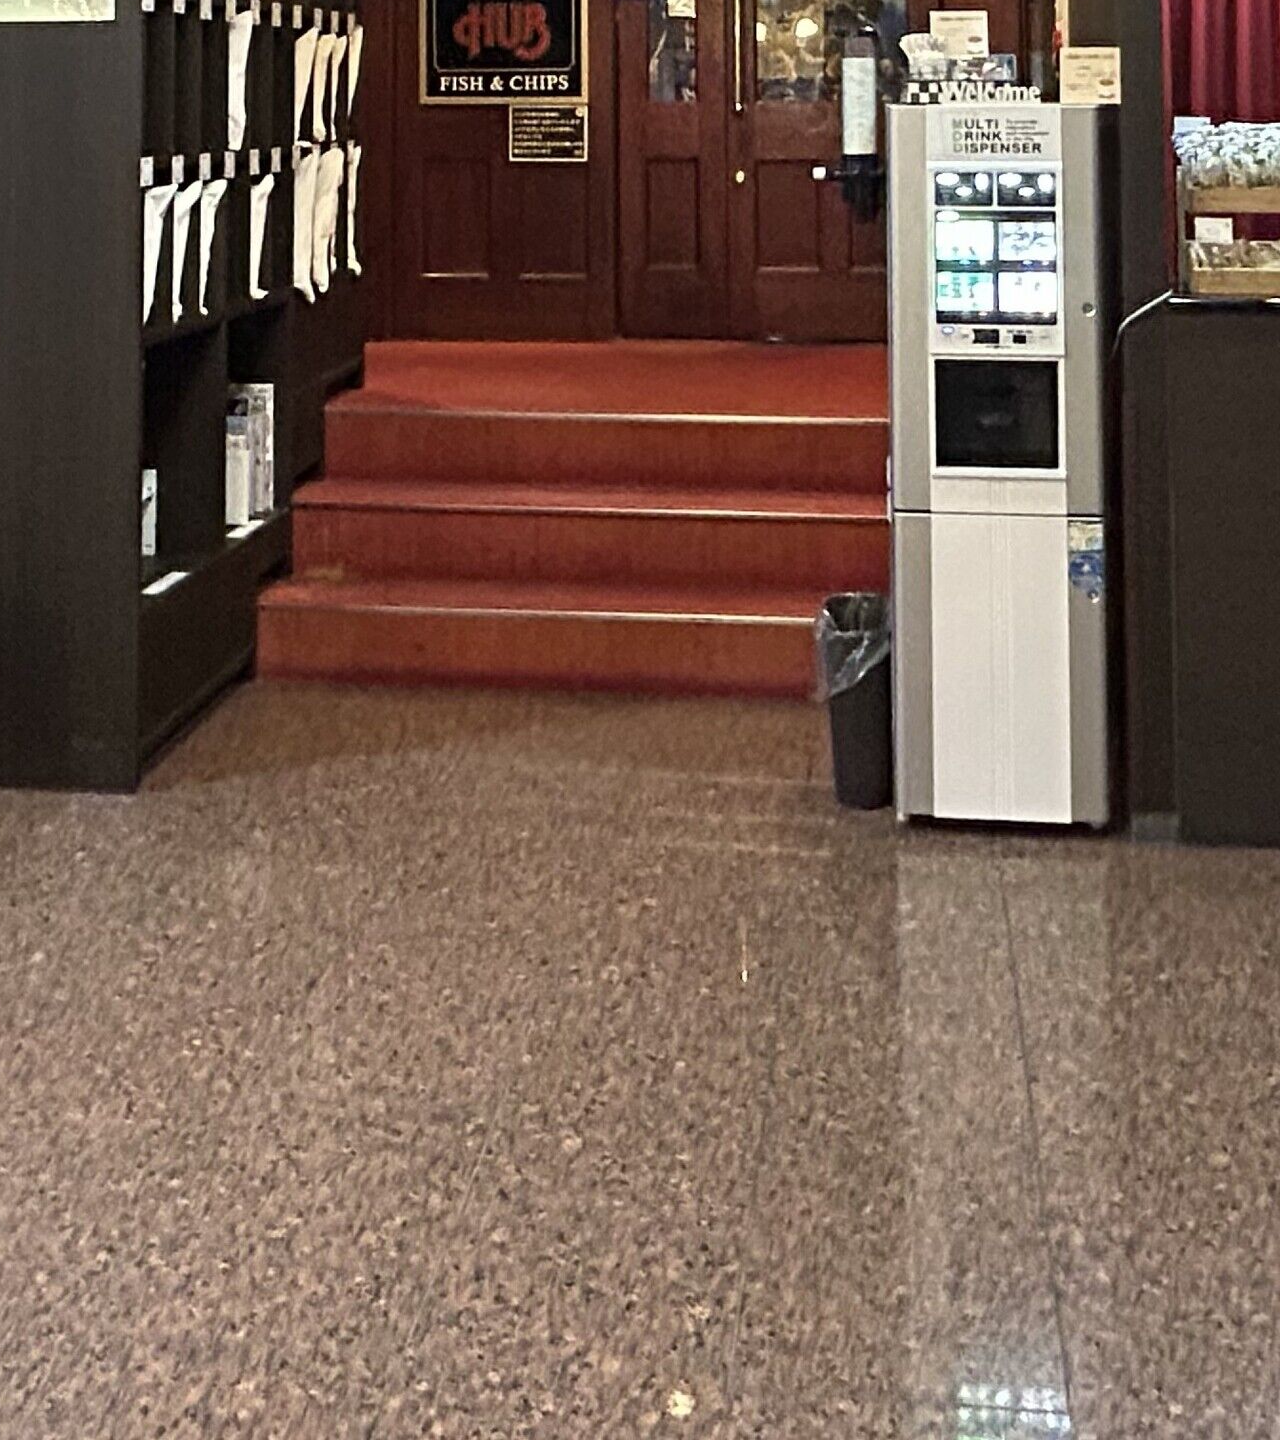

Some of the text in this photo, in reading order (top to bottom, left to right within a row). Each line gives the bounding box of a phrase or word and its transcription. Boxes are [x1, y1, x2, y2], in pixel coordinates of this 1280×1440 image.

[453, 1, 552, 60] HUB
[440, 74, 570, 91] FISH & CHIPS
[941, 80, 1041, 103] Welcome
[952, 118, 999, 130] MULTI
[952, 131, 1002, 142] DRINK
[953, 142, 1042, 154] DISPENSER
